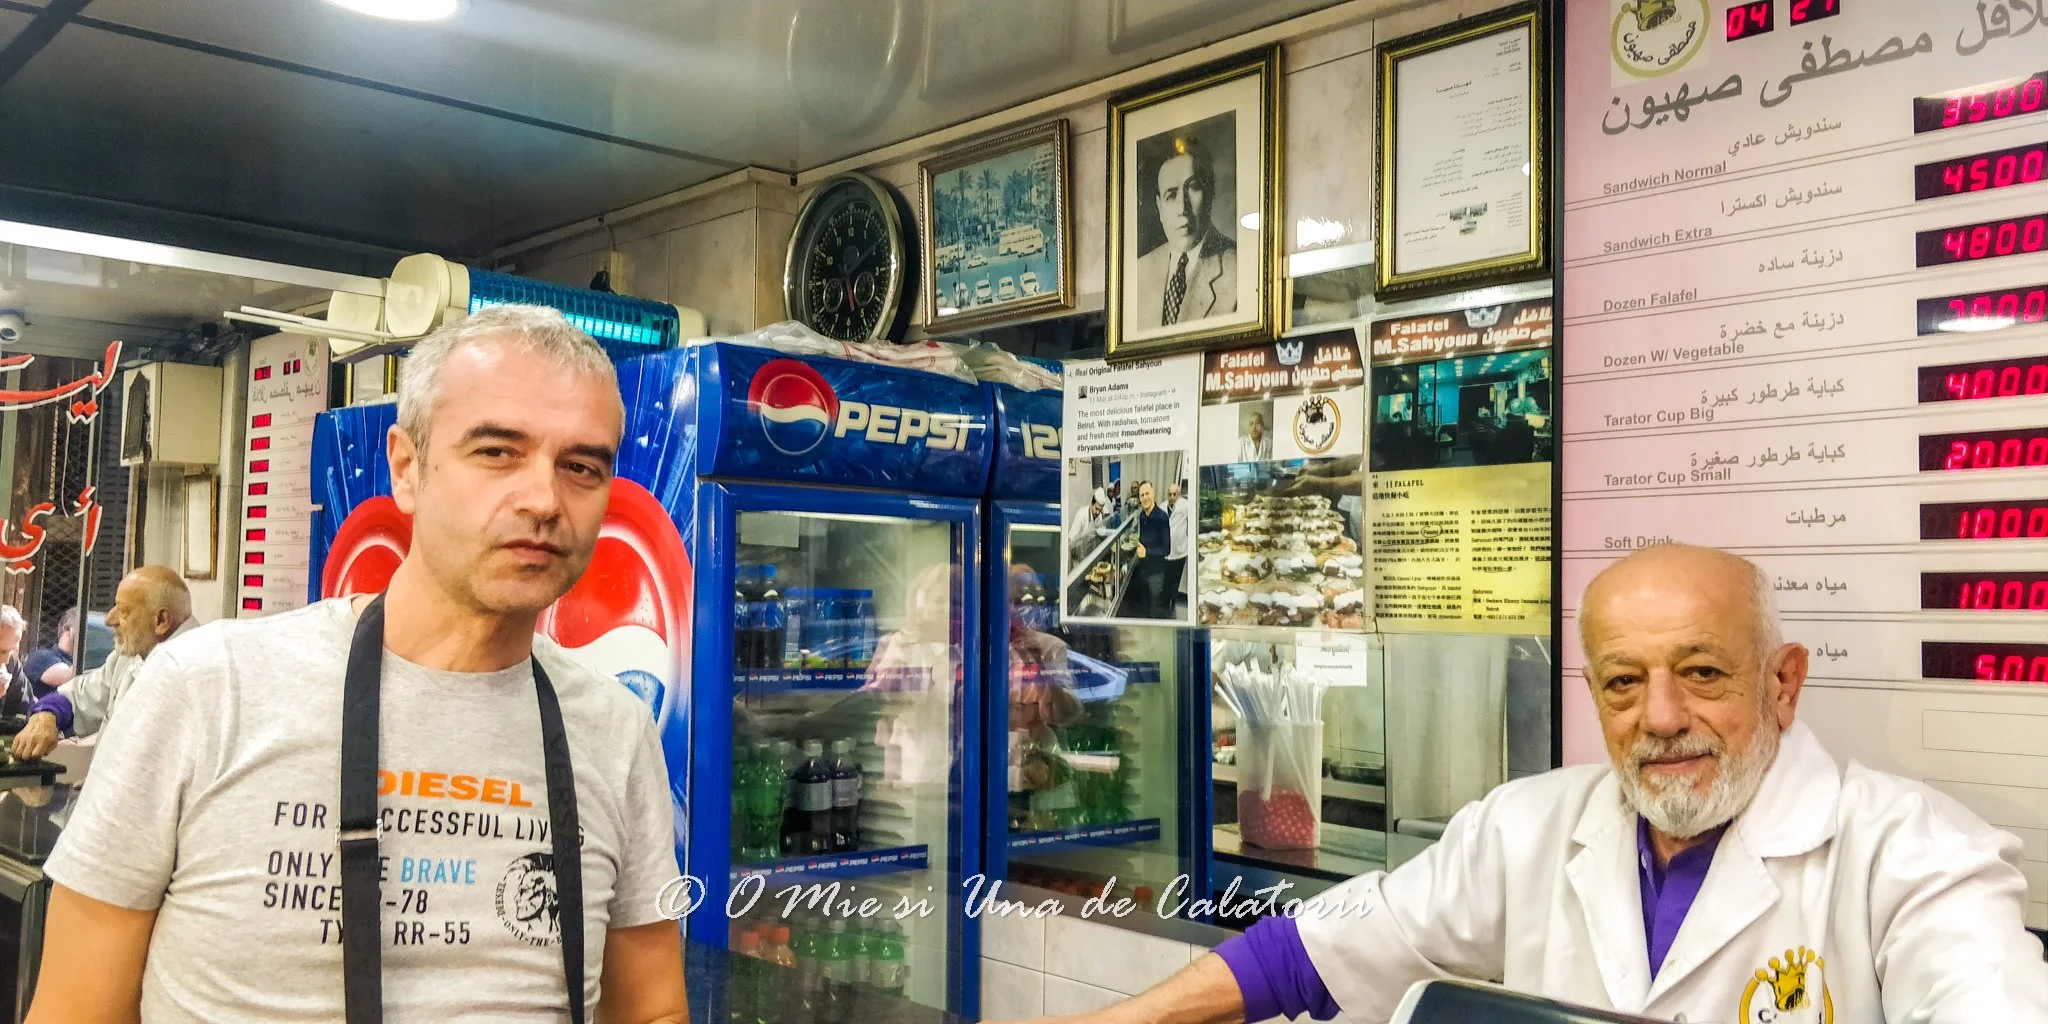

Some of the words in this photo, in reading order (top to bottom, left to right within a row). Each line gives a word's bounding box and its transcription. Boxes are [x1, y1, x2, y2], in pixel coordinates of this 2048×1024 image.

[1727, 3, 1767, 38] 04
[1760, 32, 1932, 108] مصطفى
[1602, 74, 1742, 135] صهيون
[1943, 79, 2044, 128] 3500
[1774, 118, 1842, 145] سندويش
[1728, 132, 1766, 157] عادي
[1603, 173, 1670, 195] Sandwich
[1675, 160, 1726, 181] Normal
[1943, 149, 2045, 192] 4500
[1721, 194, 1766, 217] اكسترا
[1775, 182, 1842, 209] سندويش
[1603, 233, 1670, 253] Sandwich
[1675, 226, 1713, 241] Extra
[1944, 218, 2046, 259] 4800
[1758, 256, 1794, 273] ساده
[1801, 248, 1843, 268] دزينة
[1603, 297, 1646, 312] Dozen
[1651, 288, 1697, 305] Falafel
[1390, 318, 1449, 336] Falafel
[1720, 320, 1767, 341] خضرة
[1773, 321, 1795, 339] مع
[1802, 311, 1844, 331] دزينة
[1374, 332, 1478, 355] M.Sahyoun
[1603, 353, 1646, 368] Dozen
[1651, 350, 1668, 362] W/
[1673, 341, 1744, 360] Vegetable
[1220, 351, 1265, 369] Falafel
[1075, 368, 1088, 377] Real
[1088, 366, 1112, 376] Original
[1205, 370, 1289, 392] M.Sahyoun
[1945, 364, 2048, 400] 4000
[1089, 385, 1107, 395] Bryan
[1108, 383, 1129, 393] Adams
[1140, 389, 1167, 398] Instagram
[1701, 388, 1738, 408] كبيرة
[1746, 381, 1800, 404] طرطور
[1807, 377, 1844, 399] كباية
[1078, 410, 1089, 418] The
[1090, 409, 1105, 417] most
[1106, 406, 1133, 416] delicious
[1135, 404, 1154, 413] falafel
[1155, 402, 1172, 414] place
[1173, 401, 1180, 410] in
[1603, 412, 1652, 427] Tarator
[1656, 409, 1685, 424] Cup
[1690, 407, 1714, 421] Big
[834, 400, 972, 452] PEPSI
[1077, 421, 1096, 430] Beirut.
[1098, 419, 1111, 428] With
[1112, 417, 1139, 427] radishes,
[1140, 415, 1170, 424] tomatoes
[1077, 432, 1088, 441] and
[1089, 431, 1105, 439] fresh
[1105, 430, 1120, 438] mint
[1121, 426, 1172, 438] #mouthwatering
[1077, 441, 1135, 454] #bryanadamsgetup
[1746, 446, 1800, 467] طرطور
[1807, 443, 1845, 463] كباية
[1945, 437, 2048, 470] 2000
[1691, 451, 1739, 470] صغيرة
[1604, 473, 1652, 486] Tarator
[1657, 471, 1686, 485] Cup
[1690, 468, 1731, 481] Small
[1786, 508, 1846, 527] مرطبات
[1958, 507, 2048, 540] 1000
[1604, 536, 1632, 549] Soft
[1816, 576, 1847, 595] مياه
[1960, 580, 2048, 610] 1000
[1816, 642, 1848, 661] مياه
[1975, 654, 2048, 682] 500
[274, 801, 328, 829] FOR
[380, 807, 504, 838] CCESSFUL
[267, 850, 333, 878] ONLY
[401, 857, 478, 885] BRAVE
[263, 882, 342, 912] SINCE
[393, 920, 471, 946] RR-55
